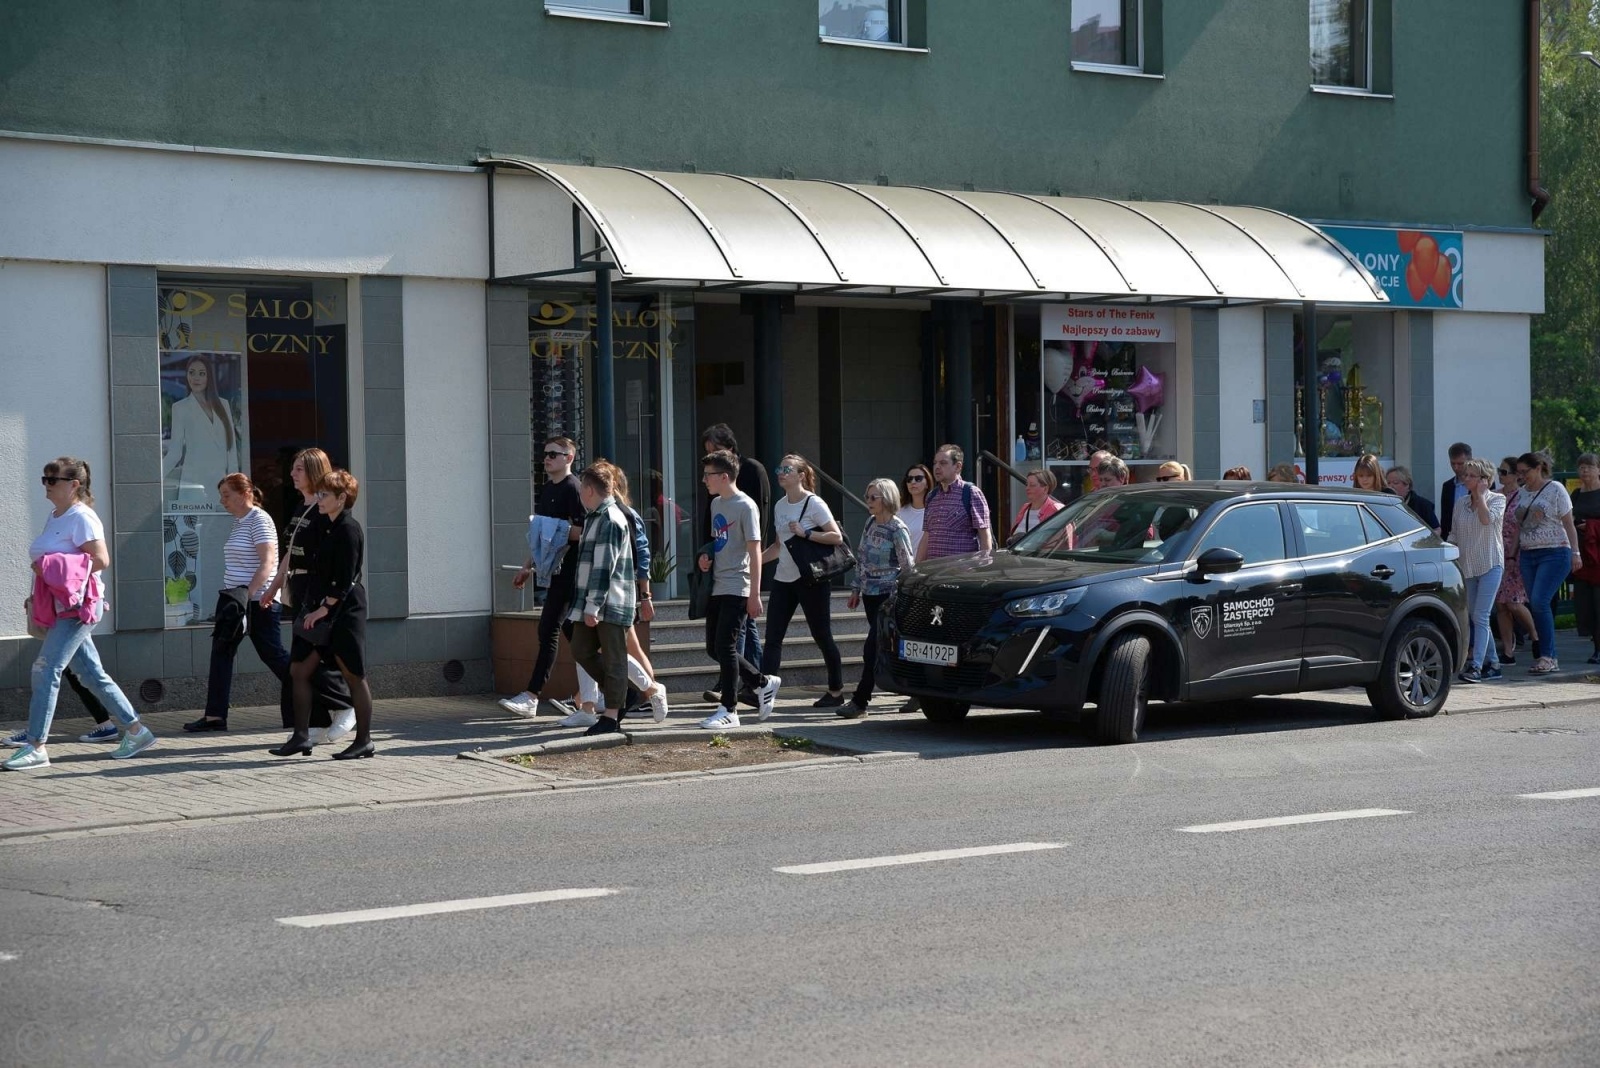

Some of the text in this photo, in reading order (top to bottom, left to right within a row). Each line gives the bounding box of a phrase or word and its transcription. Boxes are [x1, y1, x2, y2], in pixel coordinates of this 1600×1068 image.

[1356, 253, 1400, 271] ONY
[227, 293, 337, 319] SALON
[1068, 308, 1155, 319] Stars of The Fenix
[1062, 324, 1161, 338] Najlepszy do zabawy
[160, 330, 334, 354] OPTYCZNY
[1318, 475, 1347, 483] erwszy
[1223, 597, 1274, 612] SAMOCHÓD
[1223, 607, 1275, 621] ZASTĘPCZY
[906, 642, 955, 661] SR 4192P
